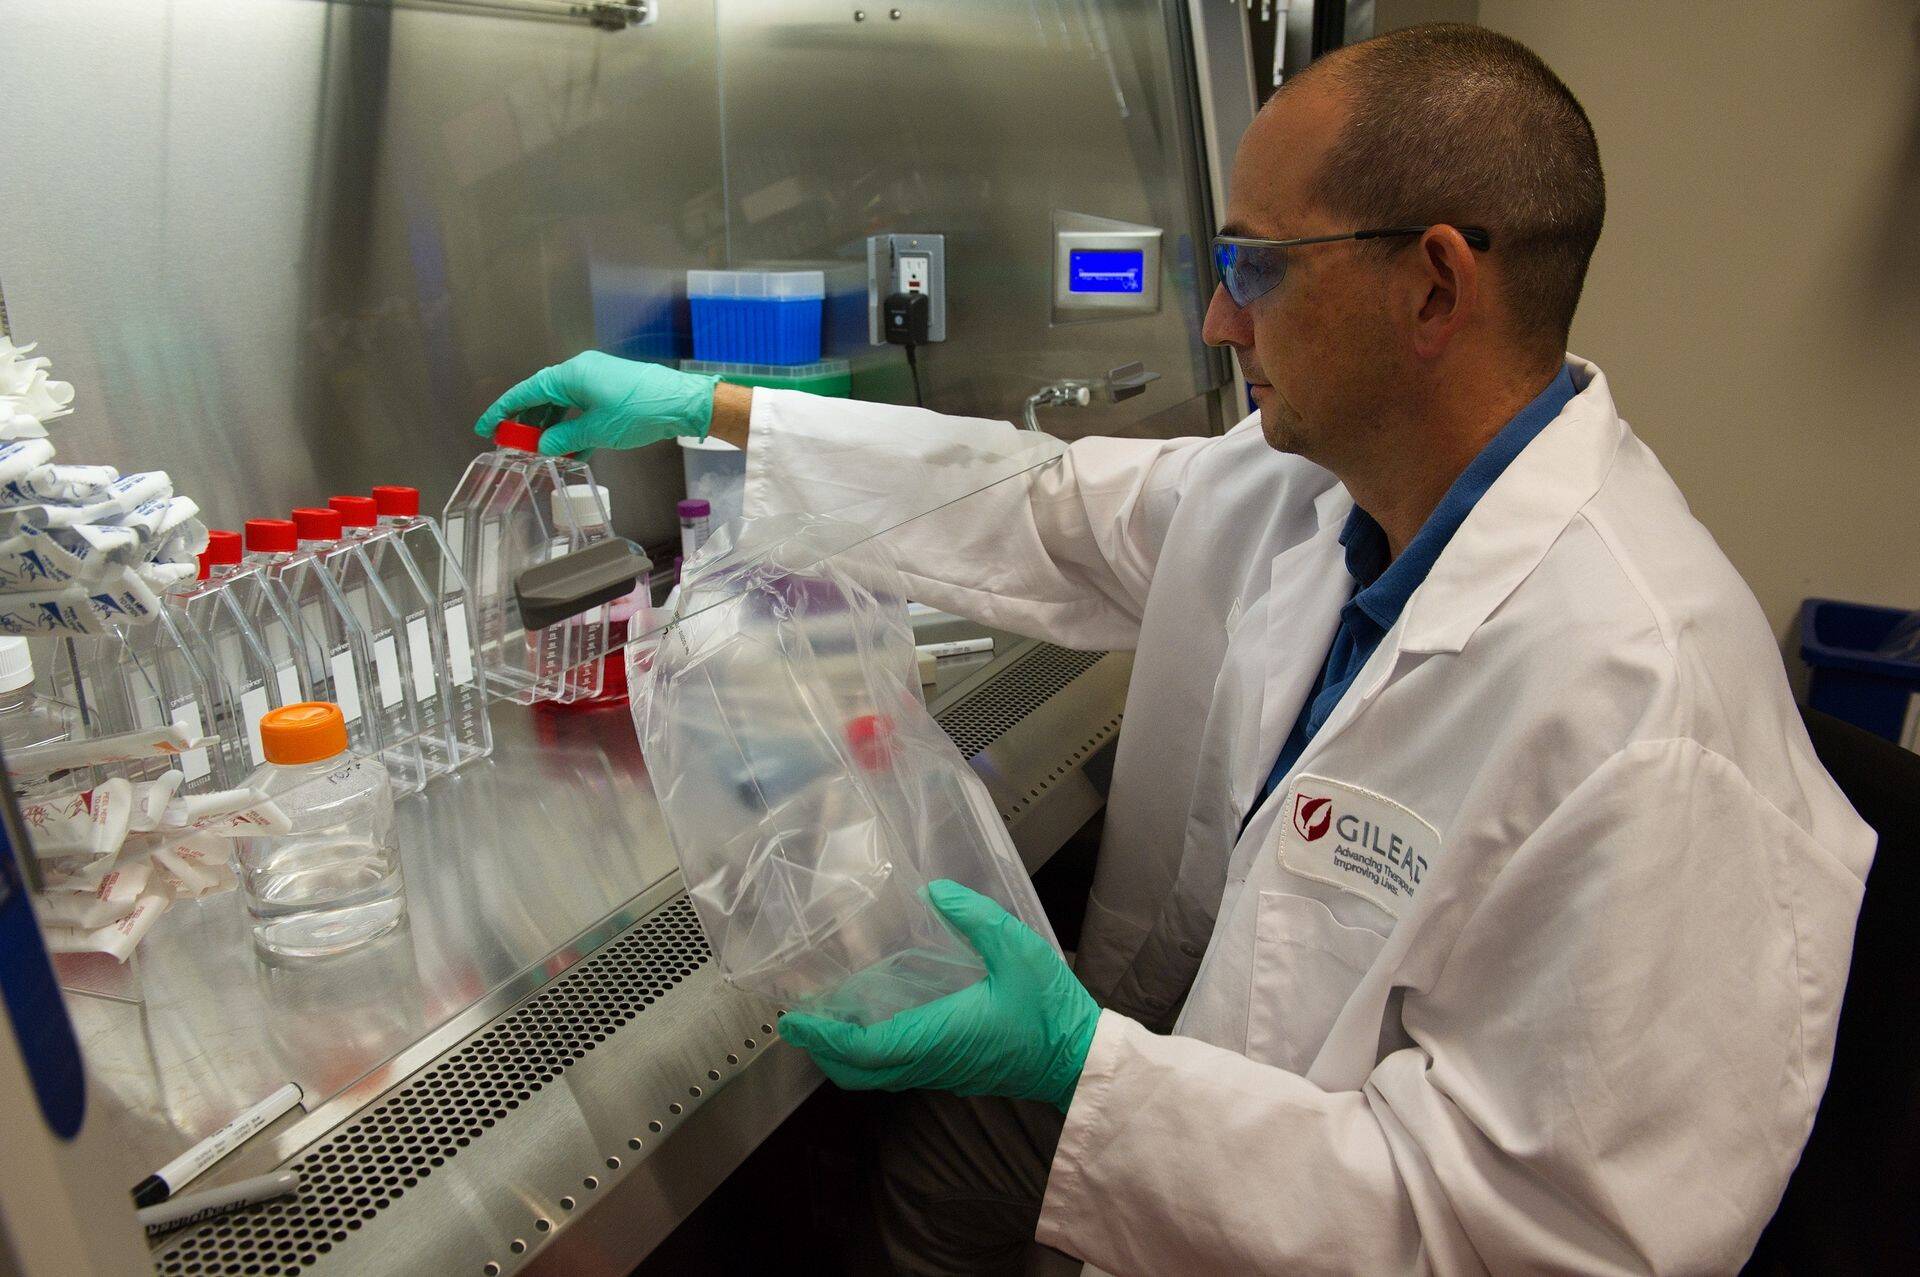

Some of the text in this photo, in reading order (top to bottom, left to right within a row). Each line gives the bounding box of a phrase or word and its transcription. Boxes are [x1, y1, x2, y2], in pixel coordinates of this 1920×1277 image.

[188, 775, 211, 789] CELLSTAR
[1333, 855, 1381, 885] Improving
[1334, 844, 1383, 874] Advancing
